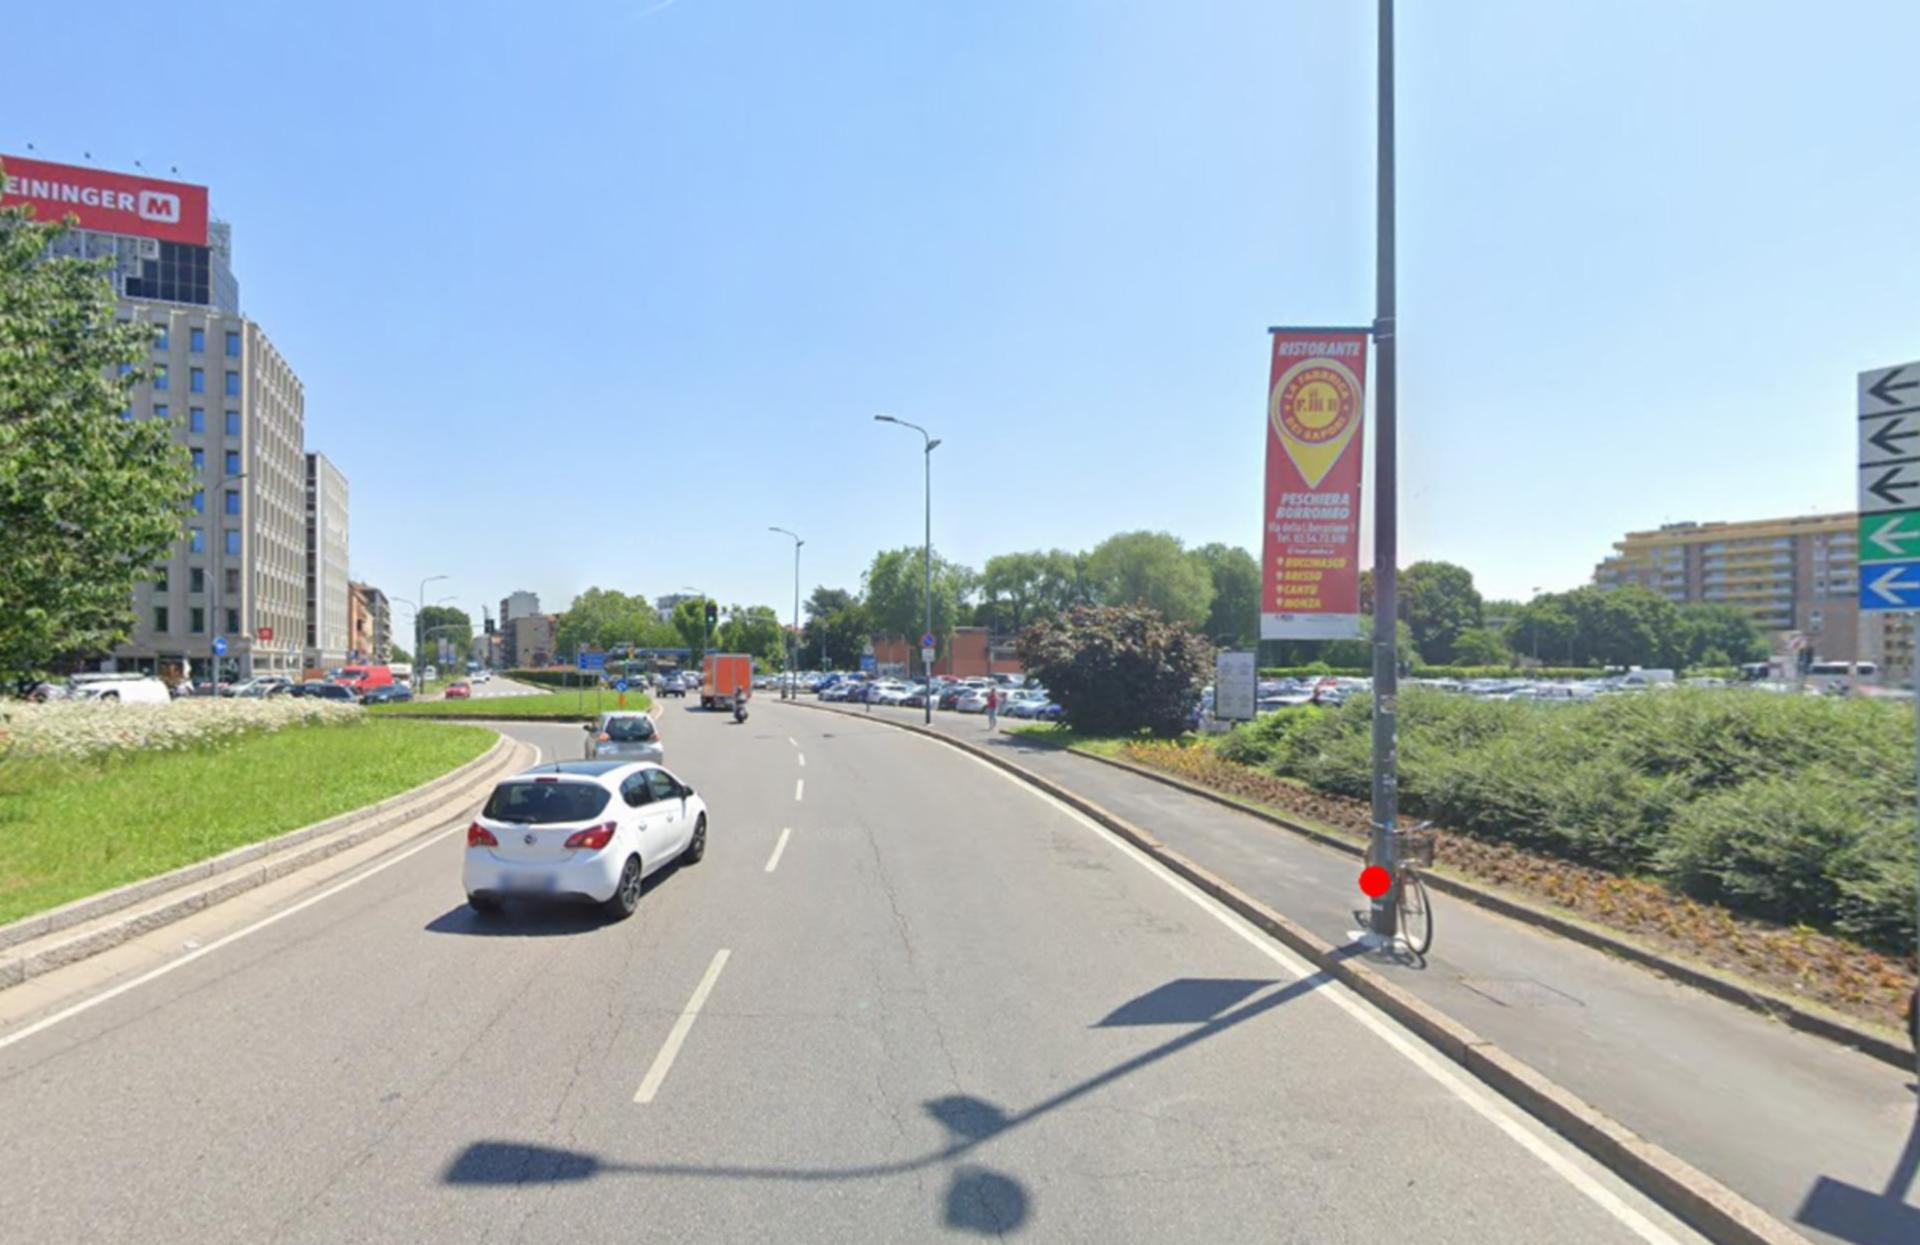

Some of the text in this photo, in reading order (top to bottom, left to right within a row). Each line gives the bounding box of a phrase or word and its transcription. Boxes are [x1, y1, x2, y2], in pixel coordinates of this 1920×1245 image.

[1279, 342, 1360, 355] RISTORANTE
[1280, 493, 1350, 505] PESCHIERA
[1276, 507, 1350, 519] BORROMEO
